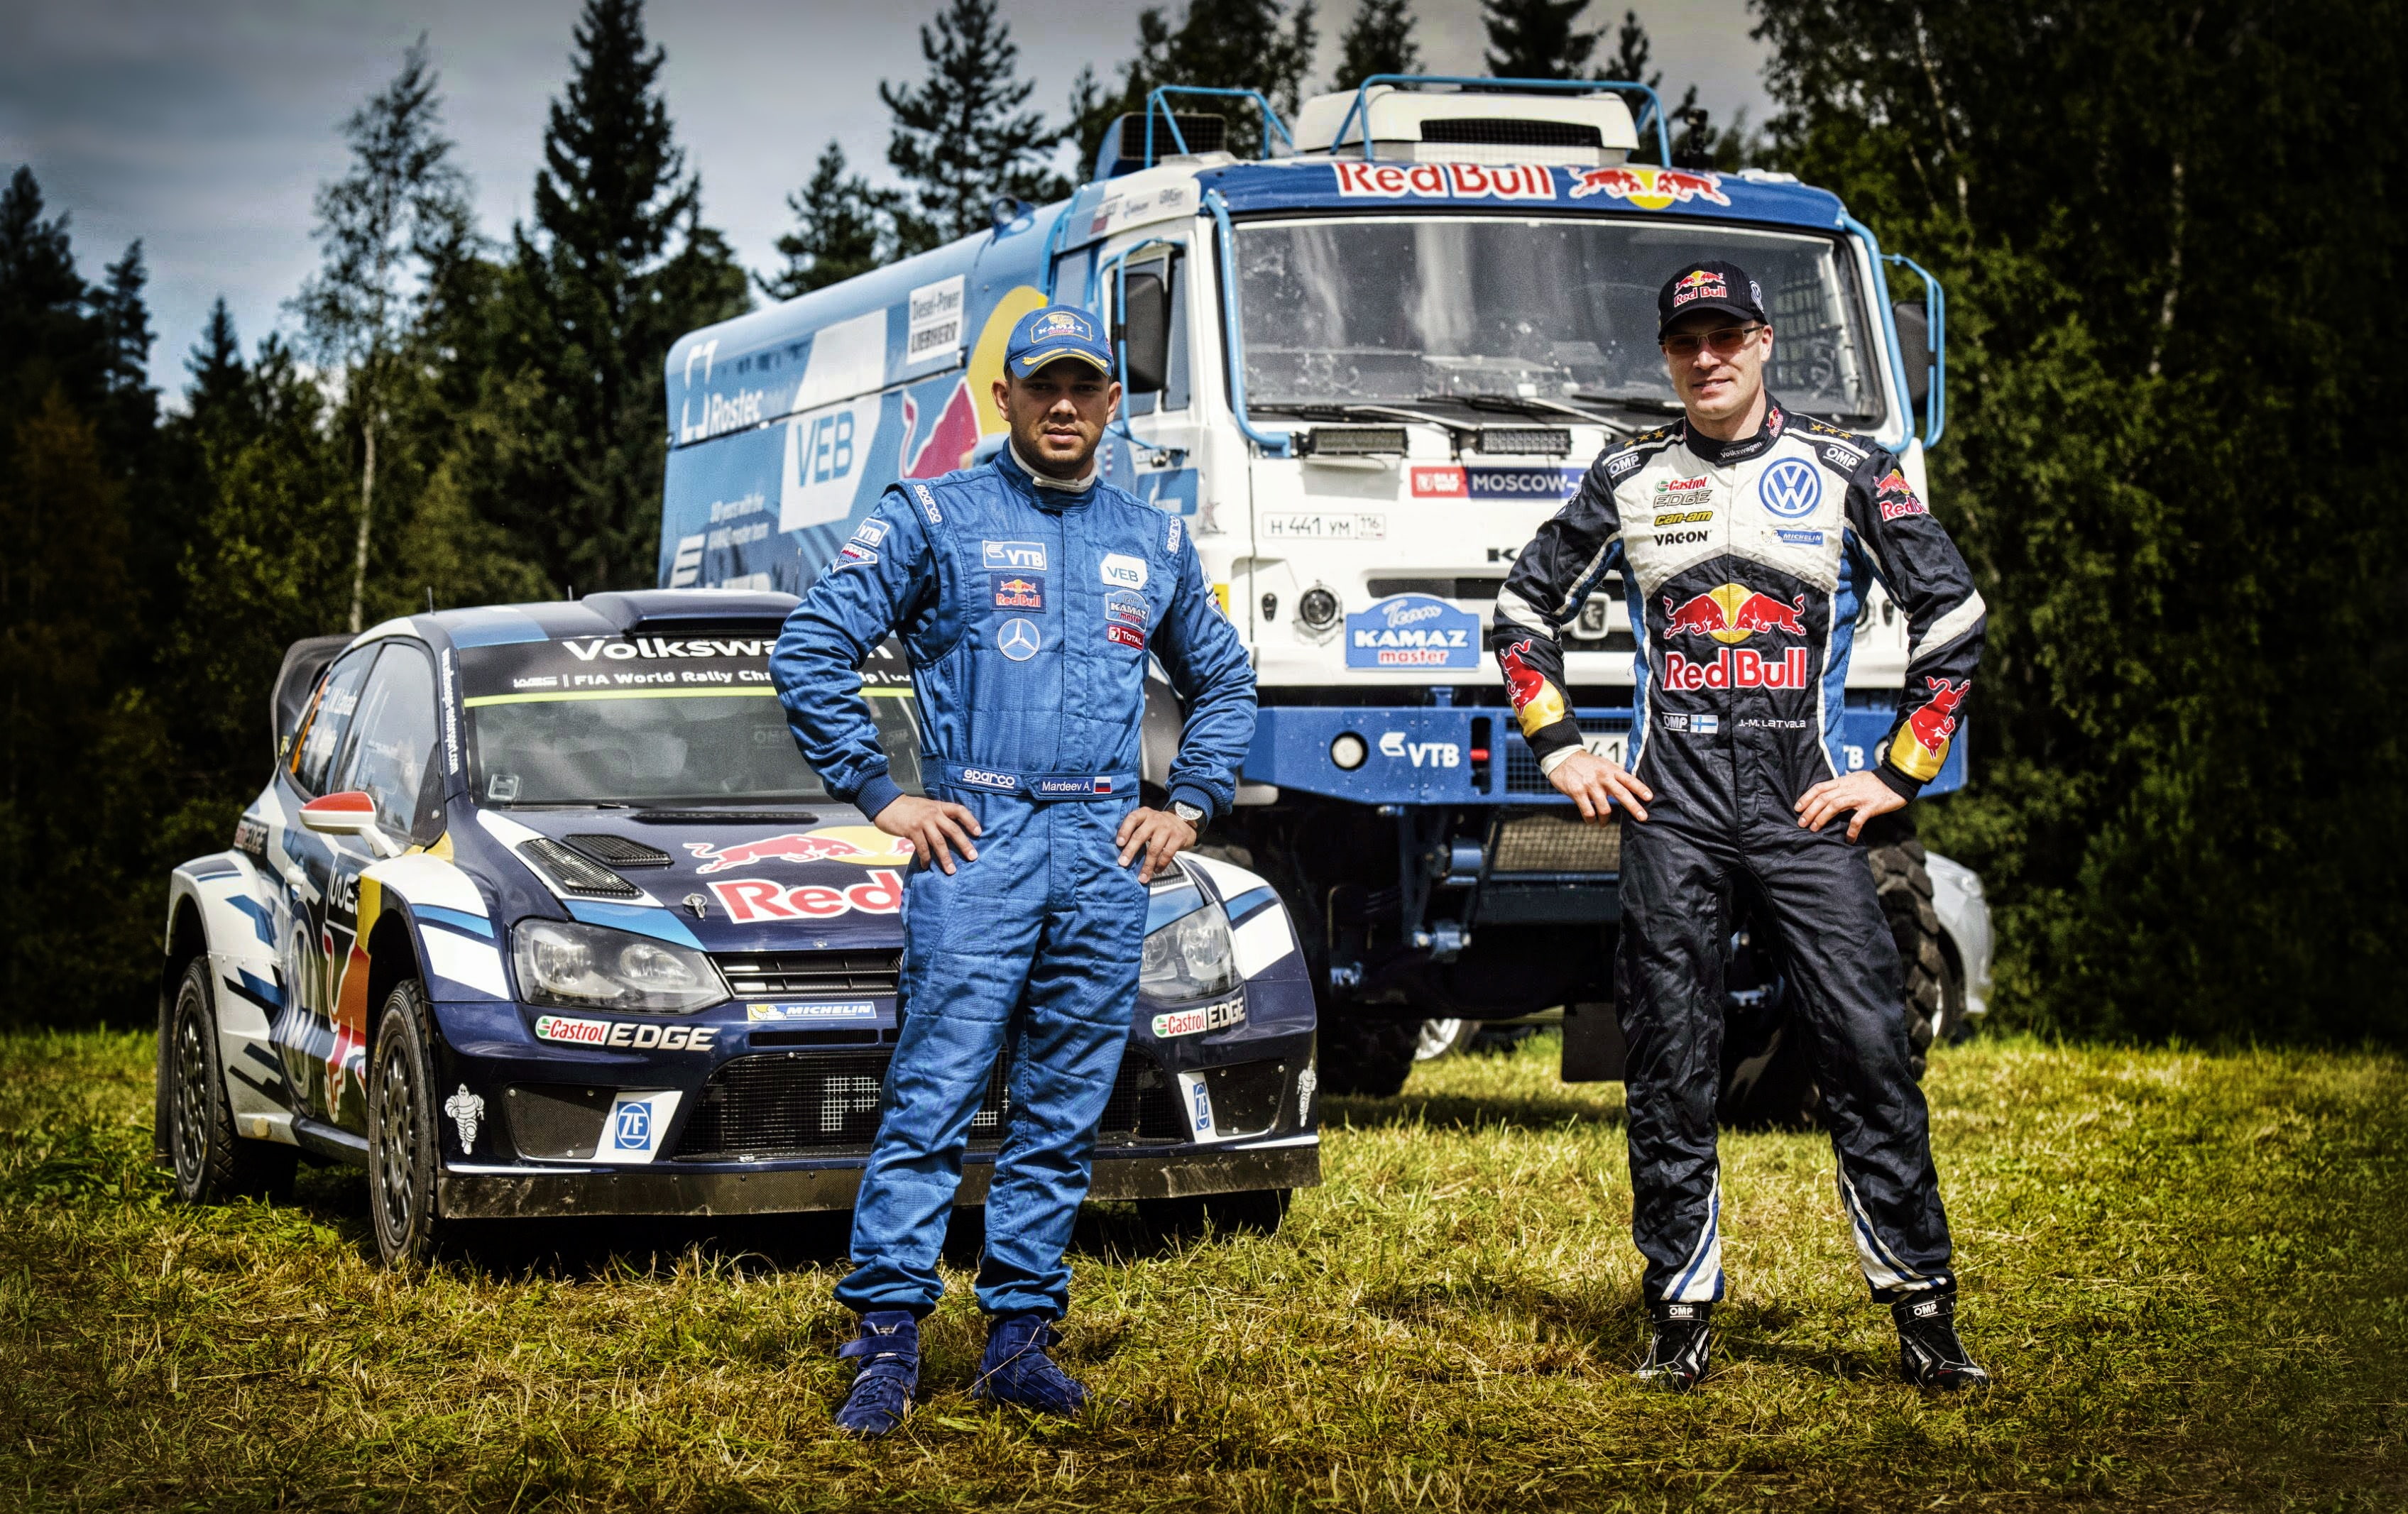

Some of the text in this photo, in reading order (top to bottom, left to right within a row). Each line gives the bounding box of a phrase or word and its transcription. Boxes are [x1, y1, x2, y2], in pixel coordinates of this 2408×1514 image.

[1333, 163, 1557, 200] Red Bull
[1674, 286, 1726, 307] Red Bull
[1038, 324, 1083, 334] KAMAZ
[710, 388, 763, 434] Rostec
[797, 410, 855, 488] VEB
[1720, 441, 1763, 459] Volkswagen
[1825, 446, 1859, 468] OMP
[1609, 454, 1639, 475] OMP
[1472, 473, 1584, 493] MOSCOW-
[1668, 476, 1708, 492] Castrol
[914, 484, 943, 523] sparco
[1653, 490, 1713, 508] EDGE
[1879, 495, 1915, 522] Red
[1289, 517, 1320, 534] 441
[1361, 517, 1380, 529] 116
[1654, 510, 1713, 526] can-am
[859, 525, 881, 542] VTB
[1166, 515, 1181, 554] sparco
[1654, 531, 1709, 546] VACON
[1783, 532, 1822, 542] MICHELIN
[1006, 549, 1044, 567] VTB
[1106, 566, 1139, 583] VEB
[996, 593, 1041, 608] Red Bull
[1110, 602, 1146, 620] KAMAZ
[1119, 613, 1142, 625] master
[1382, 599, 1443, 628] Team
[1121, 631, 1142, 646] TOTAL
[1354, 630, 1468, 647] KAMAZ
[1378, 649, 1449, 664] master
[1663, 647, 1807, 691] Red Bull
[574, 675, 610, 686] FIA
[614, 672, 675, 684] World
[681, 671, 732, 684] Rally
[1664, 715, 1687, 728] OMP
[1407, 743, 1460, 768] VTB
[963, 769, 1091, 792] sparco Mardeev A.
[709, 870, 903, 923] Red
[786, 1004, 872, 1015] MICHELIN
[1168, 997, 1246, 1035] Castrol EDGE
[549, 1019, 720, 1051] Castrol EDGE
[1195, 1087, 1209, 1125] ZF
[617, 1107, 649, 1141] ZF
[1669, 1306, 1693, 1316] OMP
[1914, 1303, 1938, 1317] OMP
